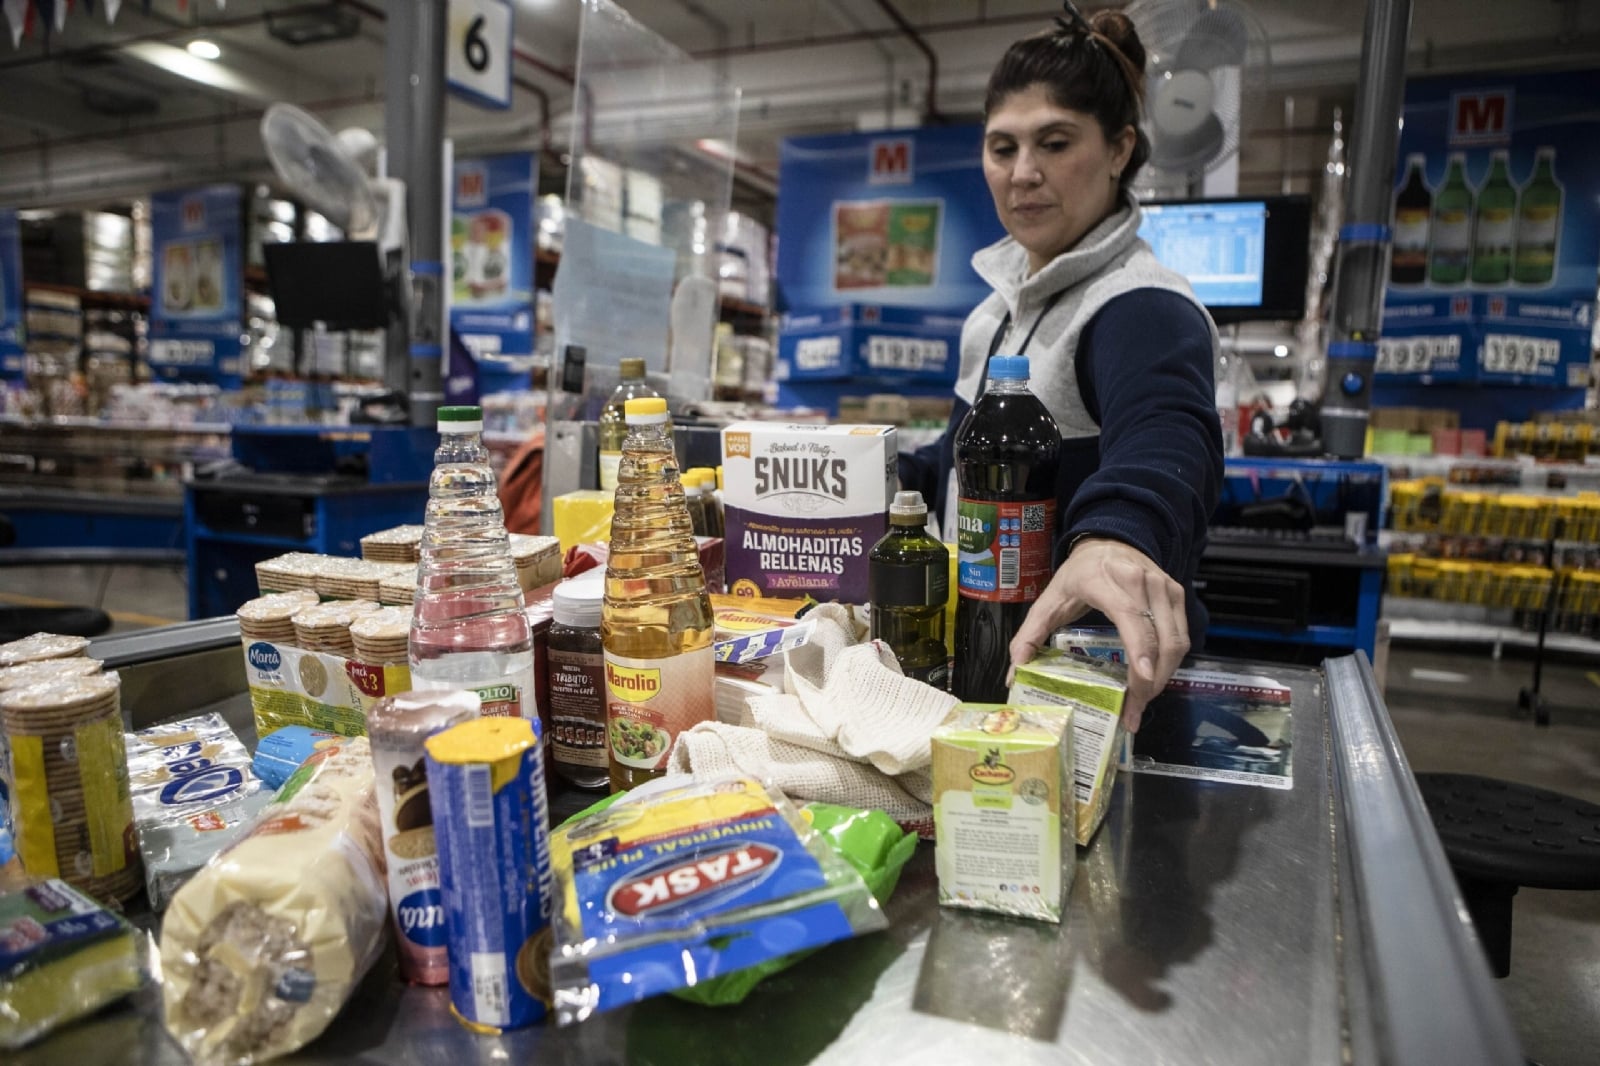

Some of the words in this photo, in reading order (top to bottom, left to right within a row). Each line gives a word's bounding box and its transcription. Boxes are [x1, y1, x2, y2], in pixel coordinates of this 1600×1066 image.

[463, 14, 490, 74] 6
[1457, 96, 1505, 134] M
[874, 140, 909, 175] M
[754, 456, 847, 500] SNUKS
[743, 530, 863, 557] ALMOHADITAS
[760, 552, 844, 575] RELLENAS
[969, 568, 981, 577] Sin
[776, 576, 829, 588] Avellana
[351, 665, 368, 677] pack
[370, 673, 379, 691] 3
[555, 673, 588, 684] TRIBUTO
[606, 663, 658, 692] Marolio
[478, 686, 509, 700] OLTO
[654, 819, 773, 855] UNIVERSAL
[632, 849, 763, 908] TASK
